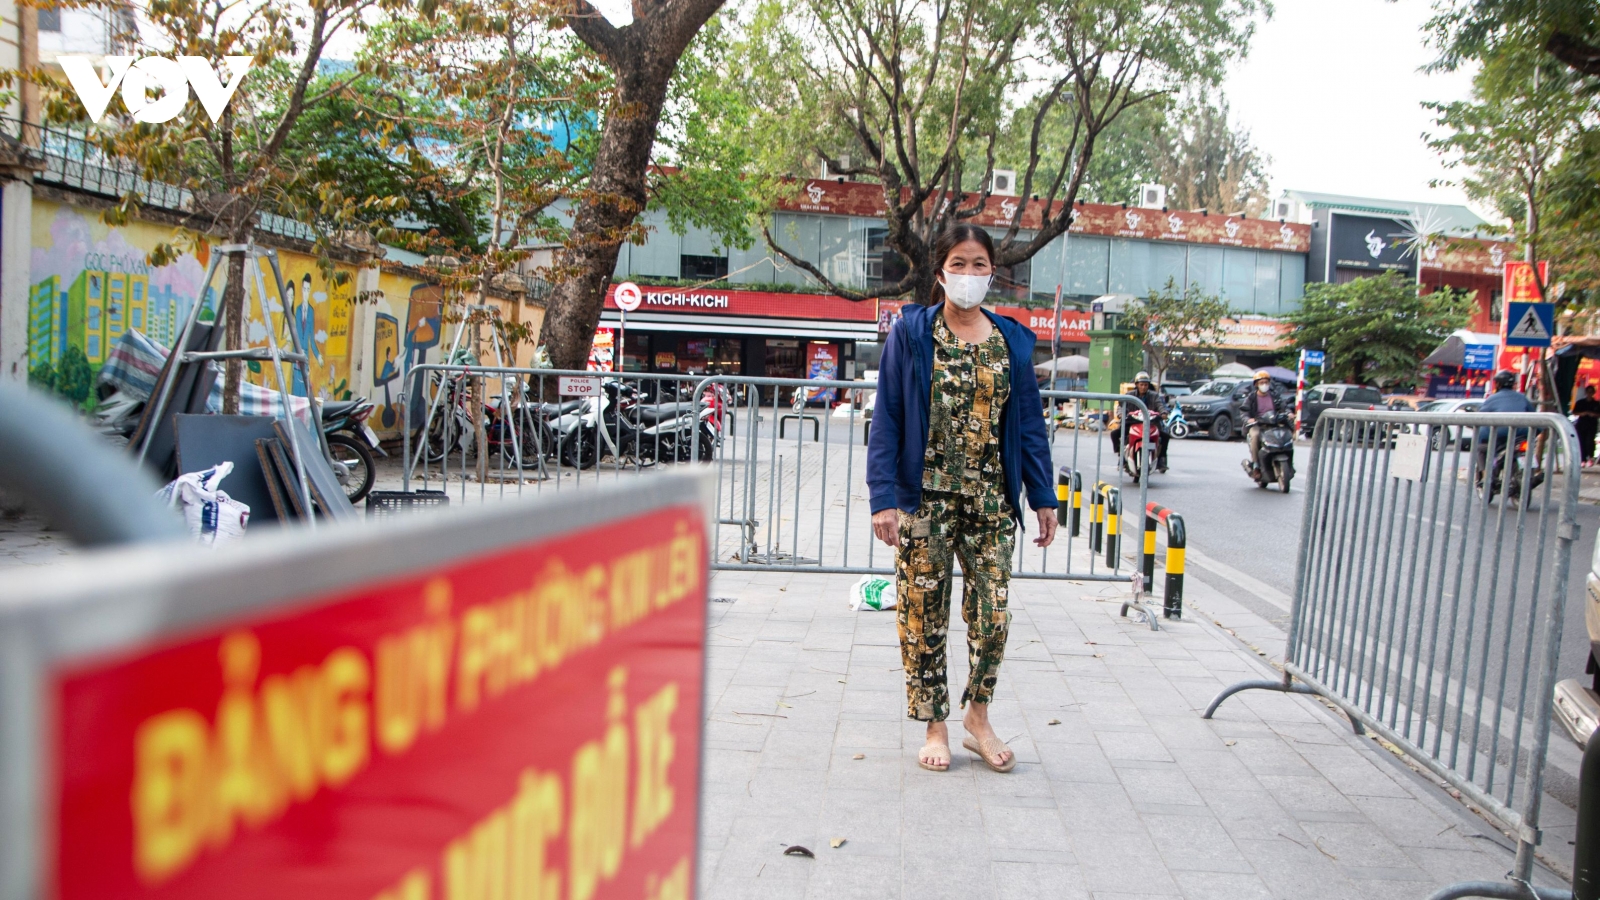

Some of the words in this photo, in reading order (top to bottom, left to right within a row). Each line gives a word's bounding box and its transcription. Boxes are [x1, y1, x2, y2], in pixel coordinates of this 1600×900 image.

[647, 292, 728, 308] KICHI-KICHI
[567, 385, 592, 393] STOP
[133, 628, 370, 881] ĐẢNG
